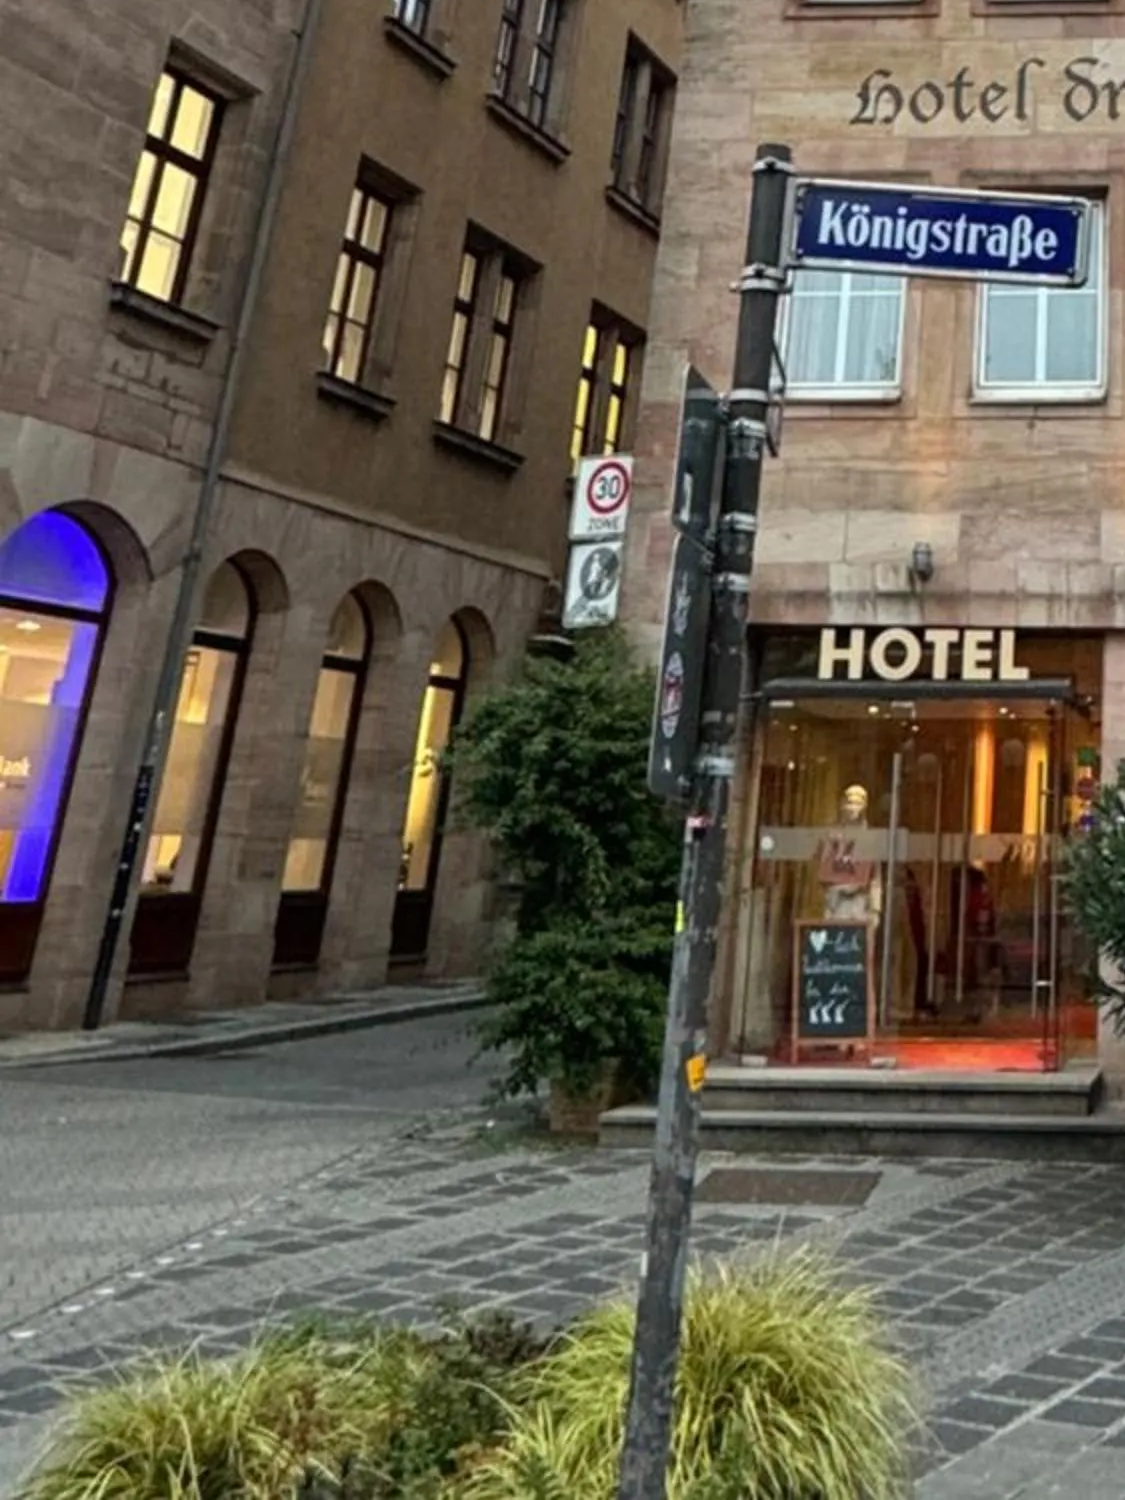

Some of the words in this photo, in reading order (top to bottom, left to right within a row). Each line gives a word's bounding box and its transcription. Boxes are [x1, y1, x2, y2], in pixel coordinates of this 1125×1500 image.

[849, 58, 1045, 126] Hotel
[817, 199, 1059, 267] Königstraße
[595, 474, 621, 500] 30
[587, 517, 619, 532] ZONE
[817, 627, 1031, 681] HOTEL
